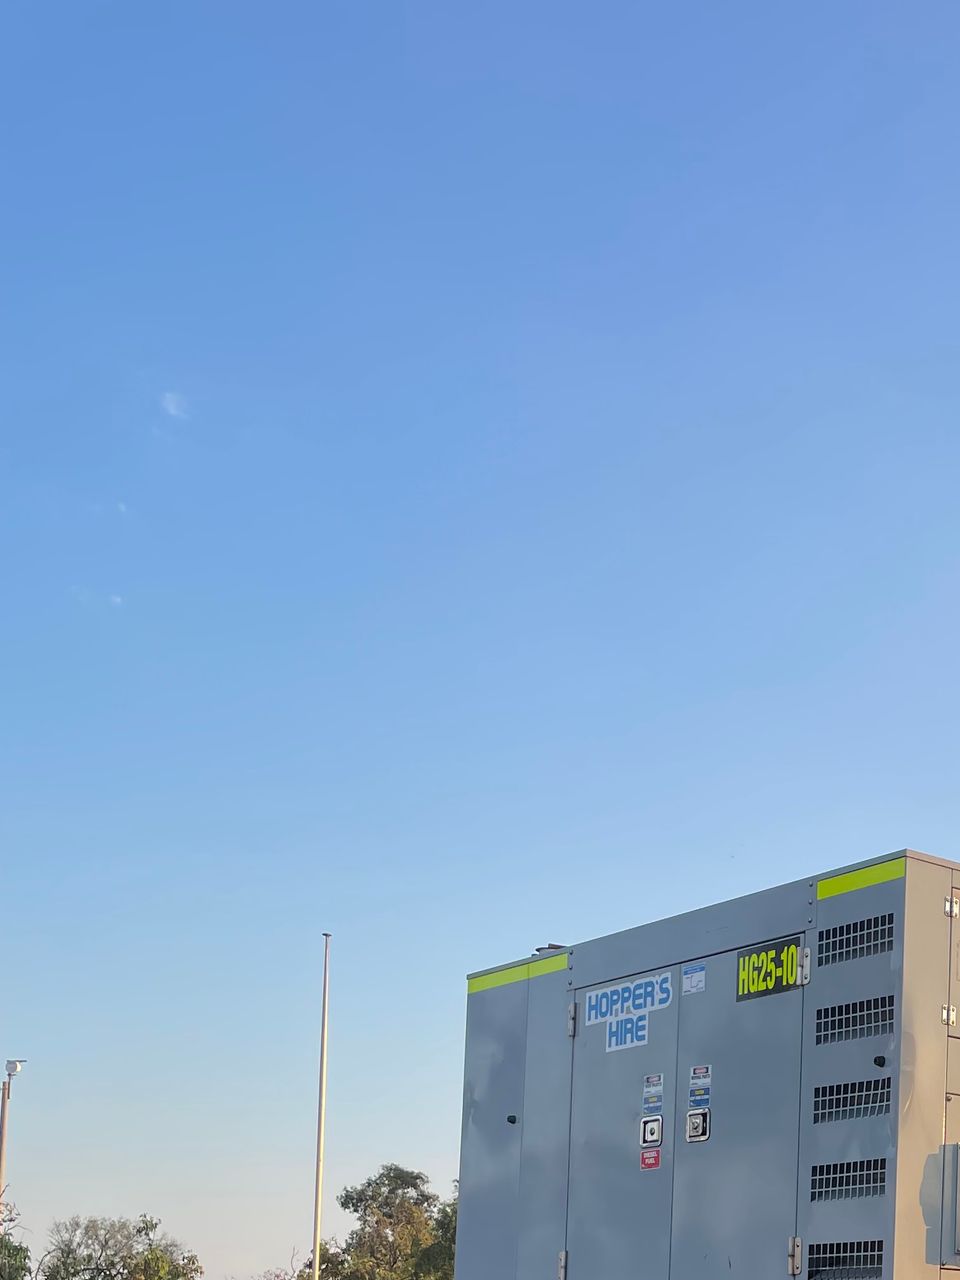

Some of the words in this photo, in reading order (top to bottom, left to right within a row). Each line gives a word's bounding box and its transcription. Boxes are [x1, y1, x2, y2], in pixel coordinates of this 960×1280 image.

[738, 944, 797, 995] HG25-10
[587, 974, 671, 1022] HOPPER'S
[607, 1014, 647, 1048] HIRE
